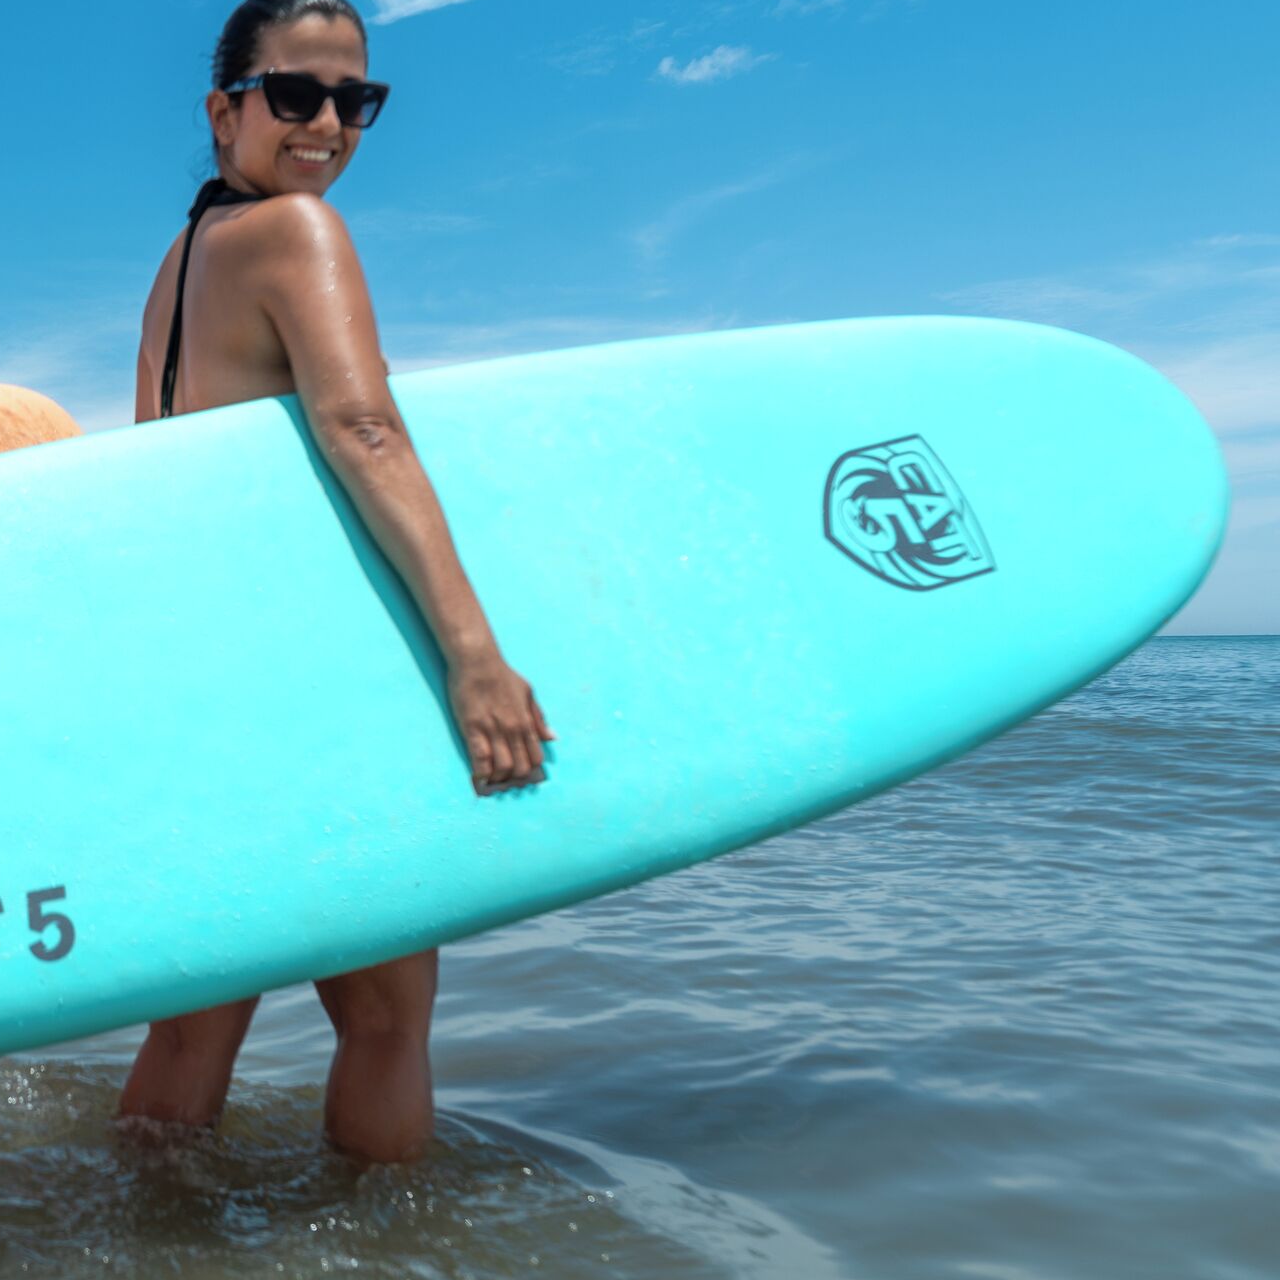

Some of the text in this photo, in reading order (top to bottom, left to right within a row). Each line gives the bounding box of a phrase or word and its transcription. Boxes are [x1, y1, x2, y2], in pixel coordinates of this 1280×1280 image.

[840, 497, 926, 553] 5
[888, 451, 982, 561] CAT
[26, 885, 76, 962] 5
